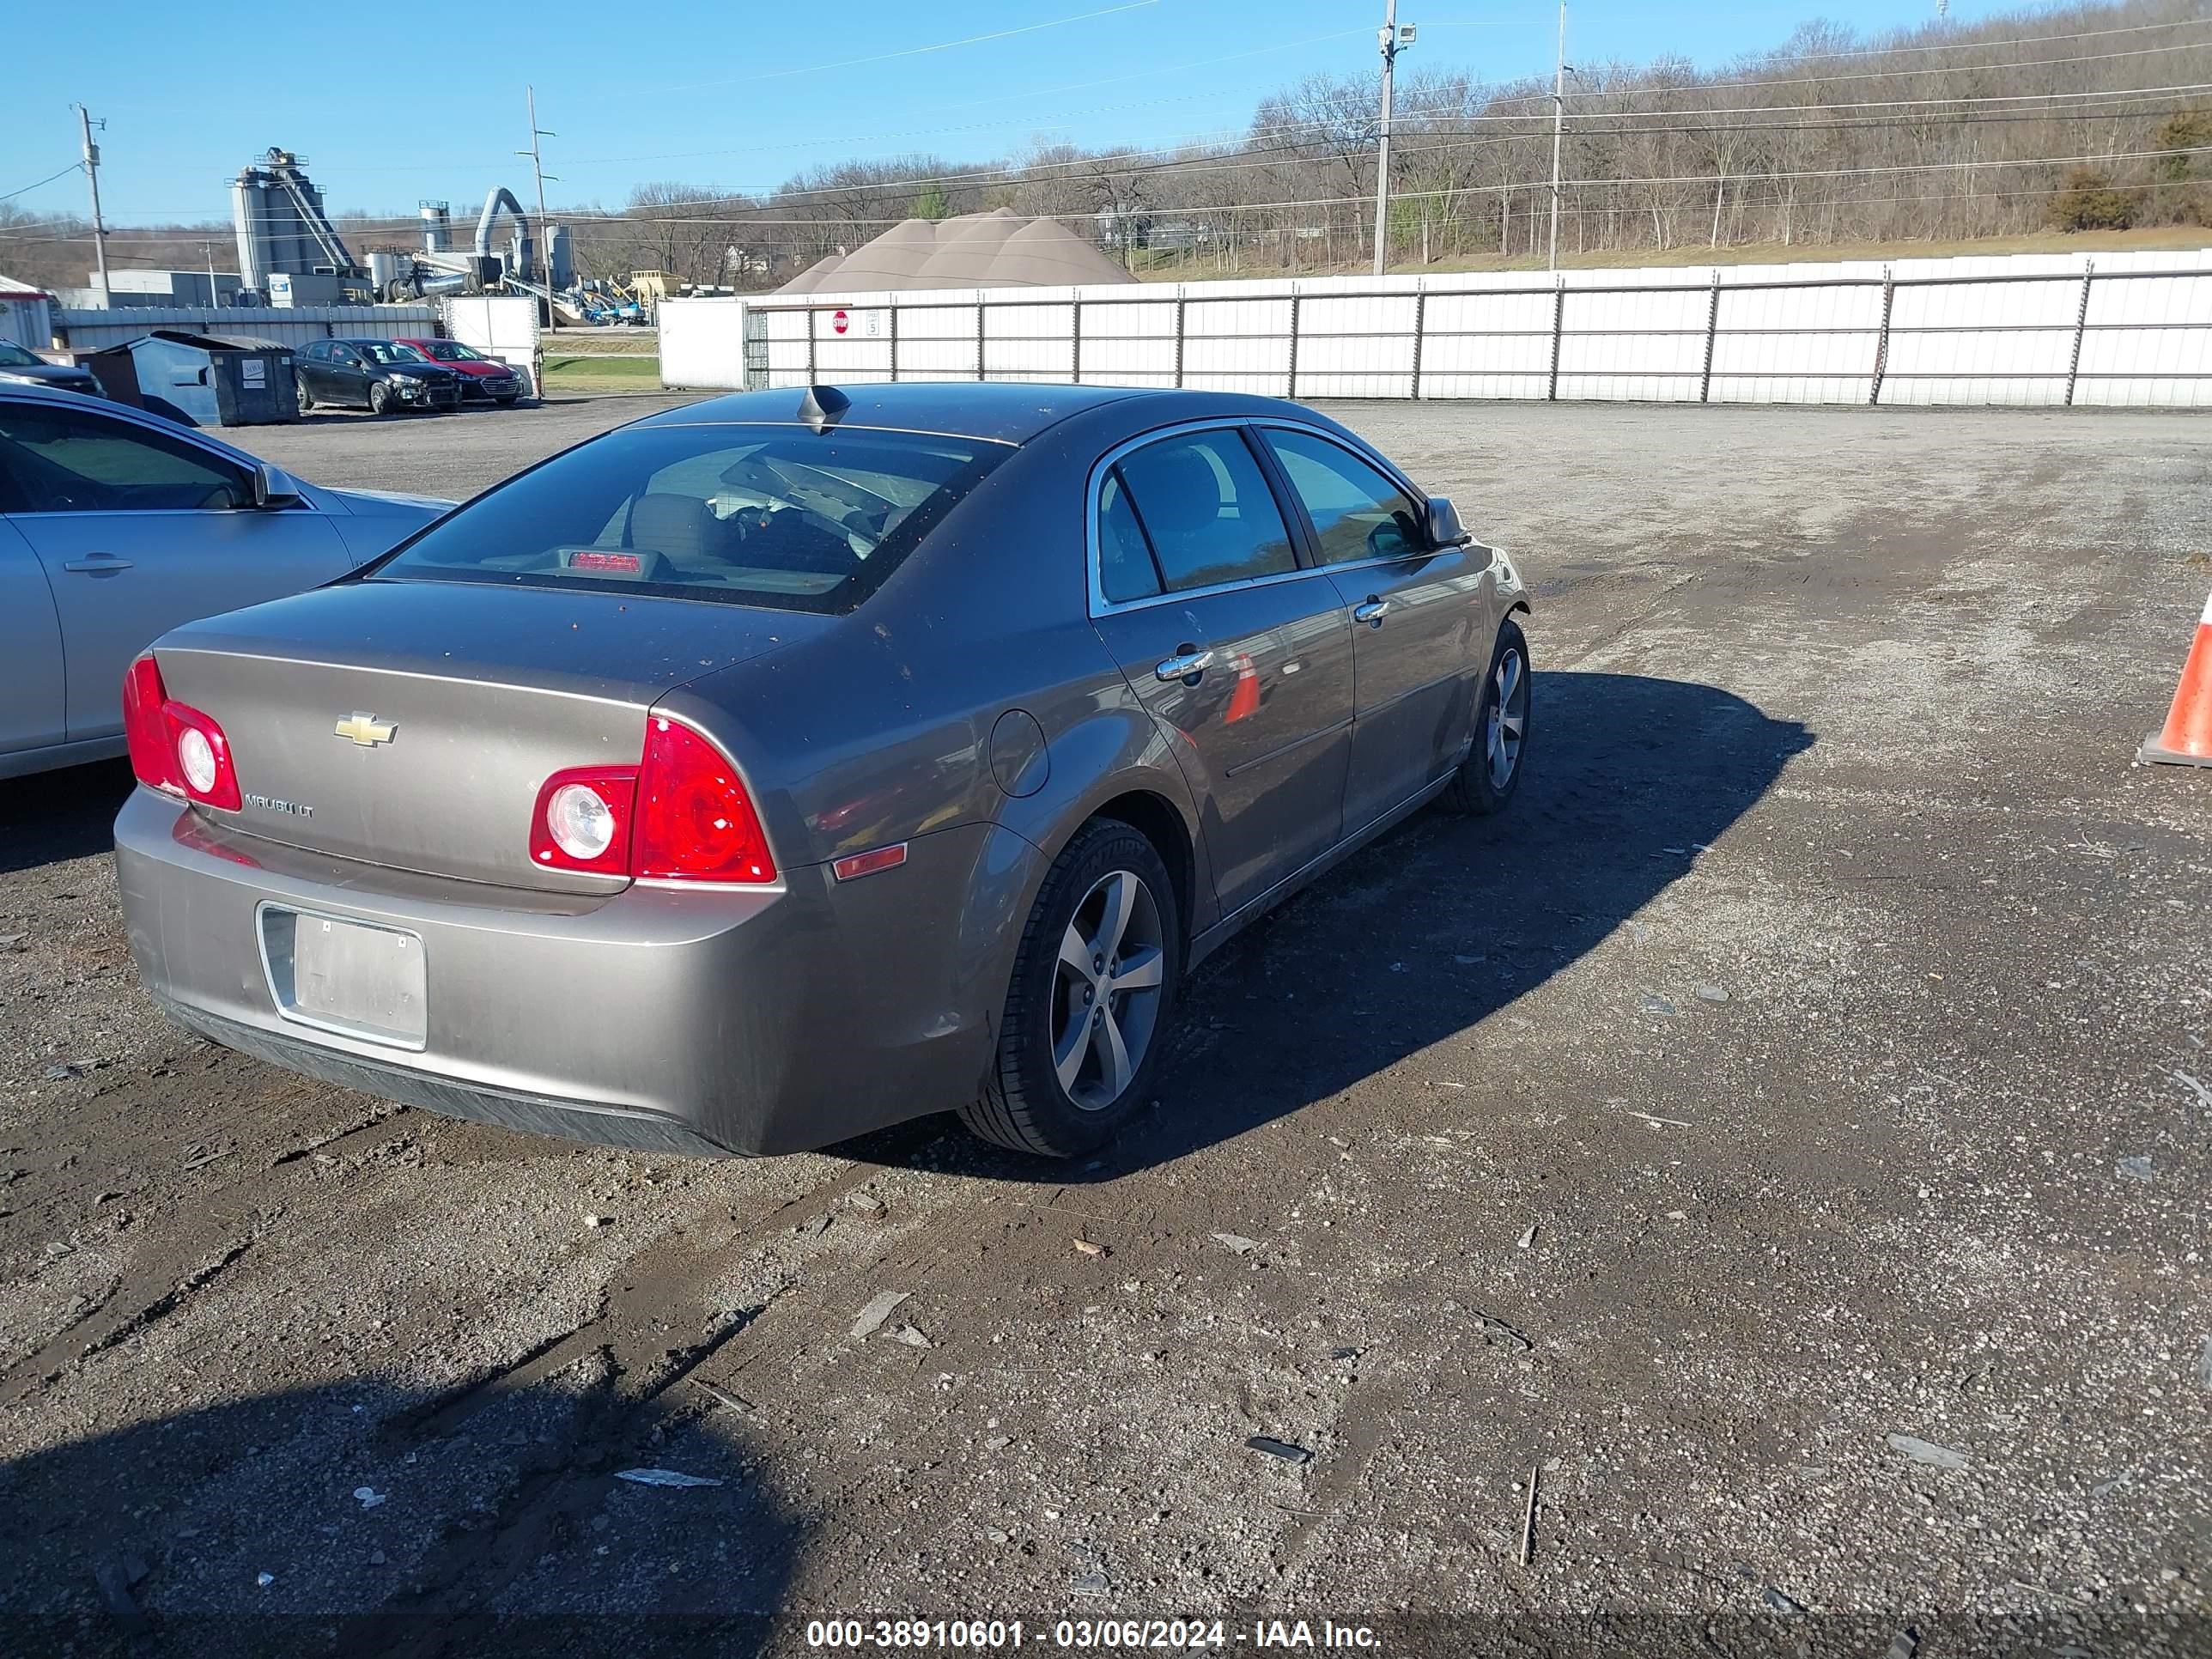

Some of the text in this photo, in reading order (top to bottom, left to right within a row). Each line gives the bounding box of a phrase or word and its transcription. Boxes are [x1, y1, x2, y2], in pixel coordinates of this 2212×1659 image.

[833, 317, 848, 328] STOP
[245, 793, 314, 818] MALIBU LT
